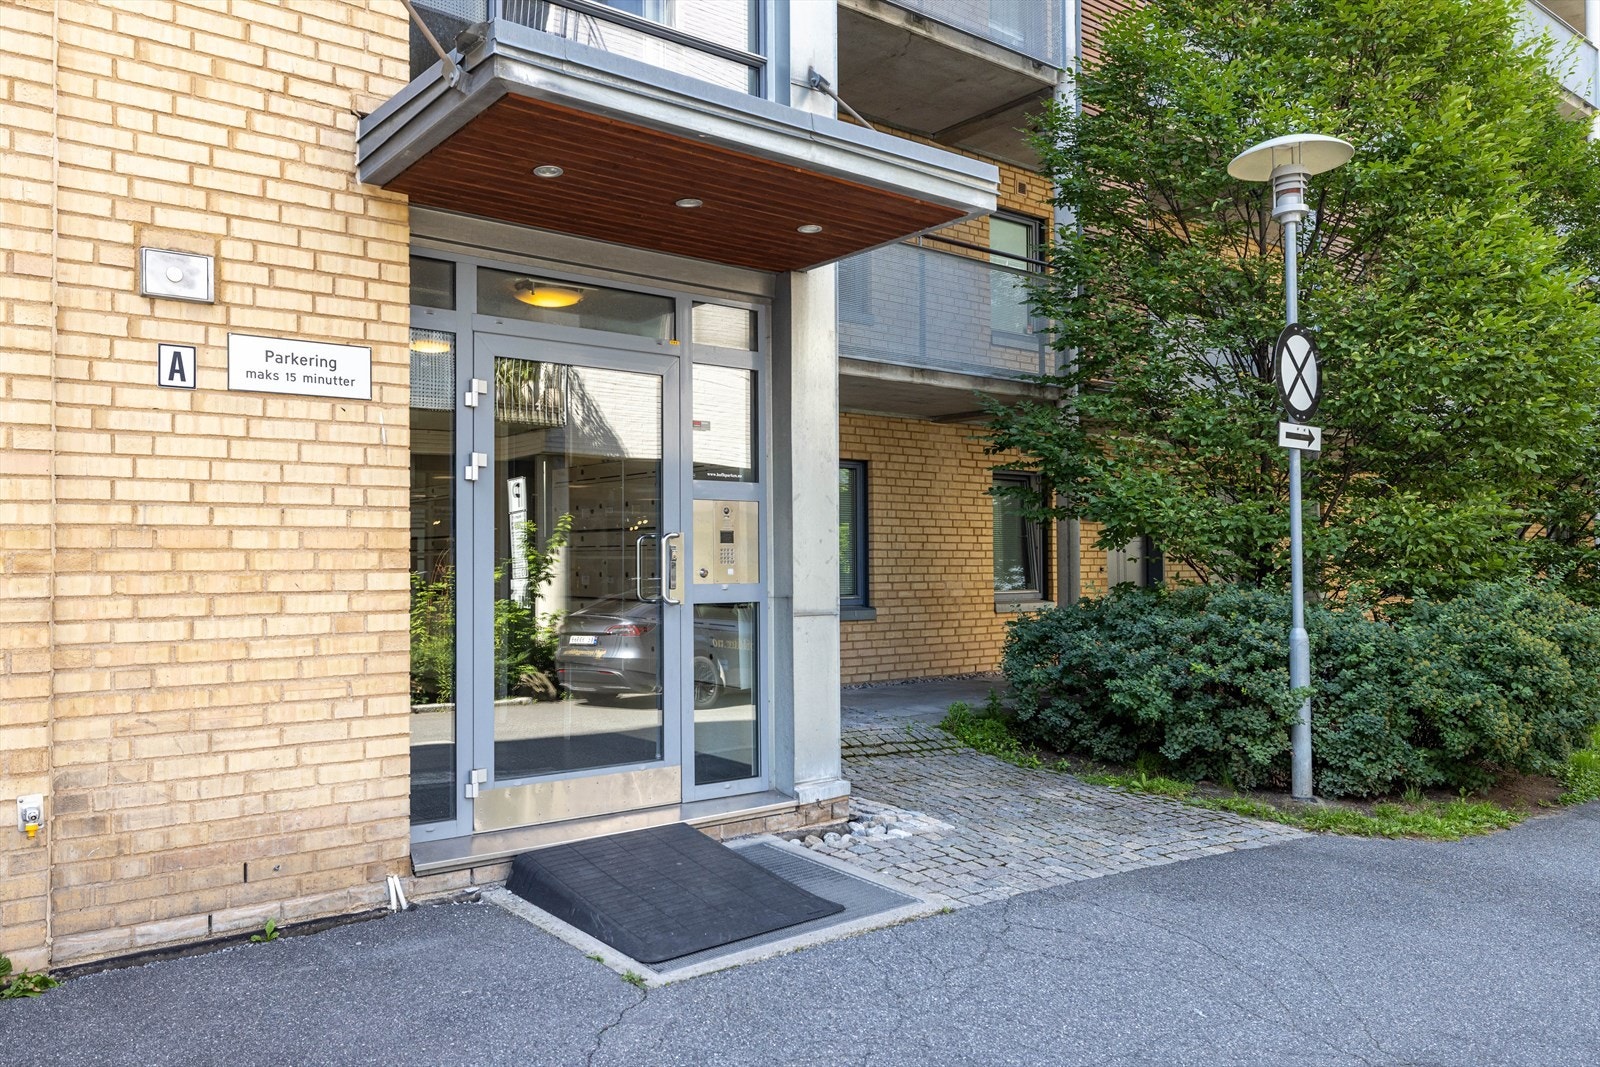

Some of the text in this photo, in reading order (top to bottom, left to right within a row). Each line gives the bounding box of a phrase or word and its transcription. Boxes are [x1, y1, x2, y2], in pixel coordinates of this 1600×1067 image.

[168, 351, 186, 382] A
[265, 350, 337, 372] Parkering
[246, 369, 355, 388] maks 15 minutter
